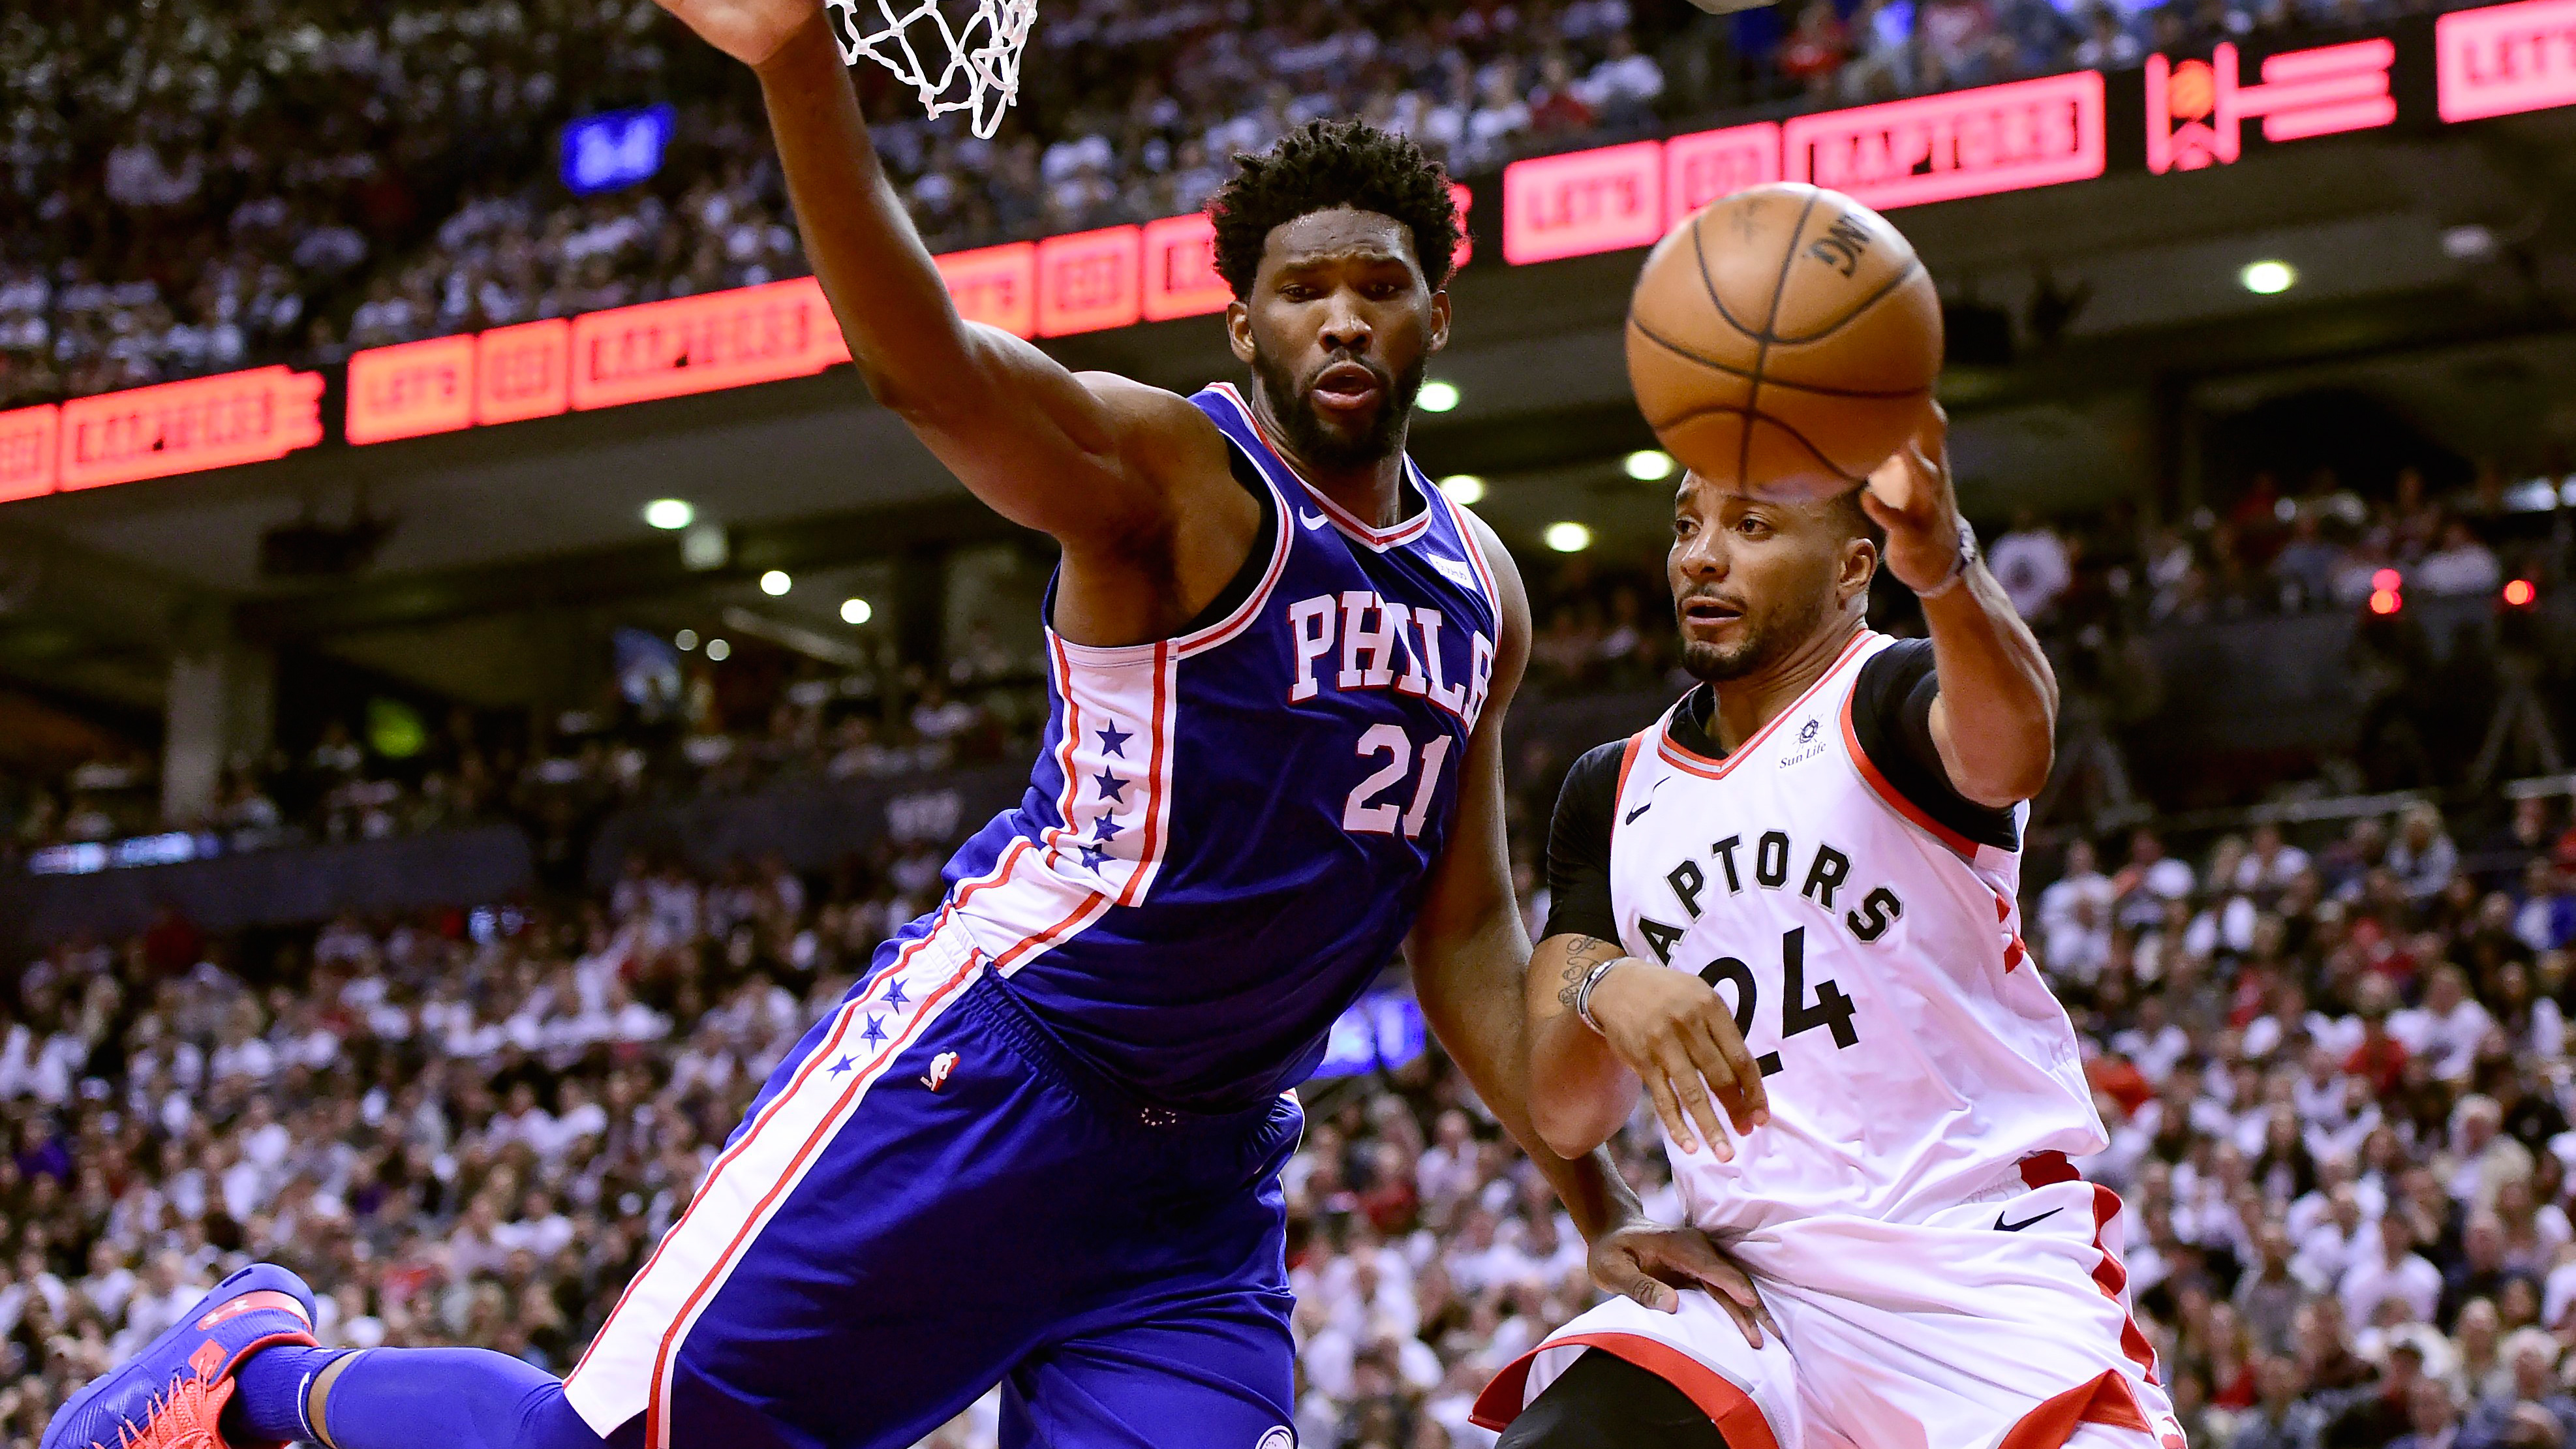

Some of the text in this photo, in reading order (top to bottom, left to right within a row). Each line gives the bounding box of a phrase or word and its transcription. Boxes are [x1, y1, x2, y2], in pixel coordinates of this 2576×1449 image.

[1343, 722, 1452, 840] 21
[1779, 741, 1826, 769] Sun Life
[1634, 828, 1905, 968] APTORS
[1698, 925, 1860, 1078] 24
